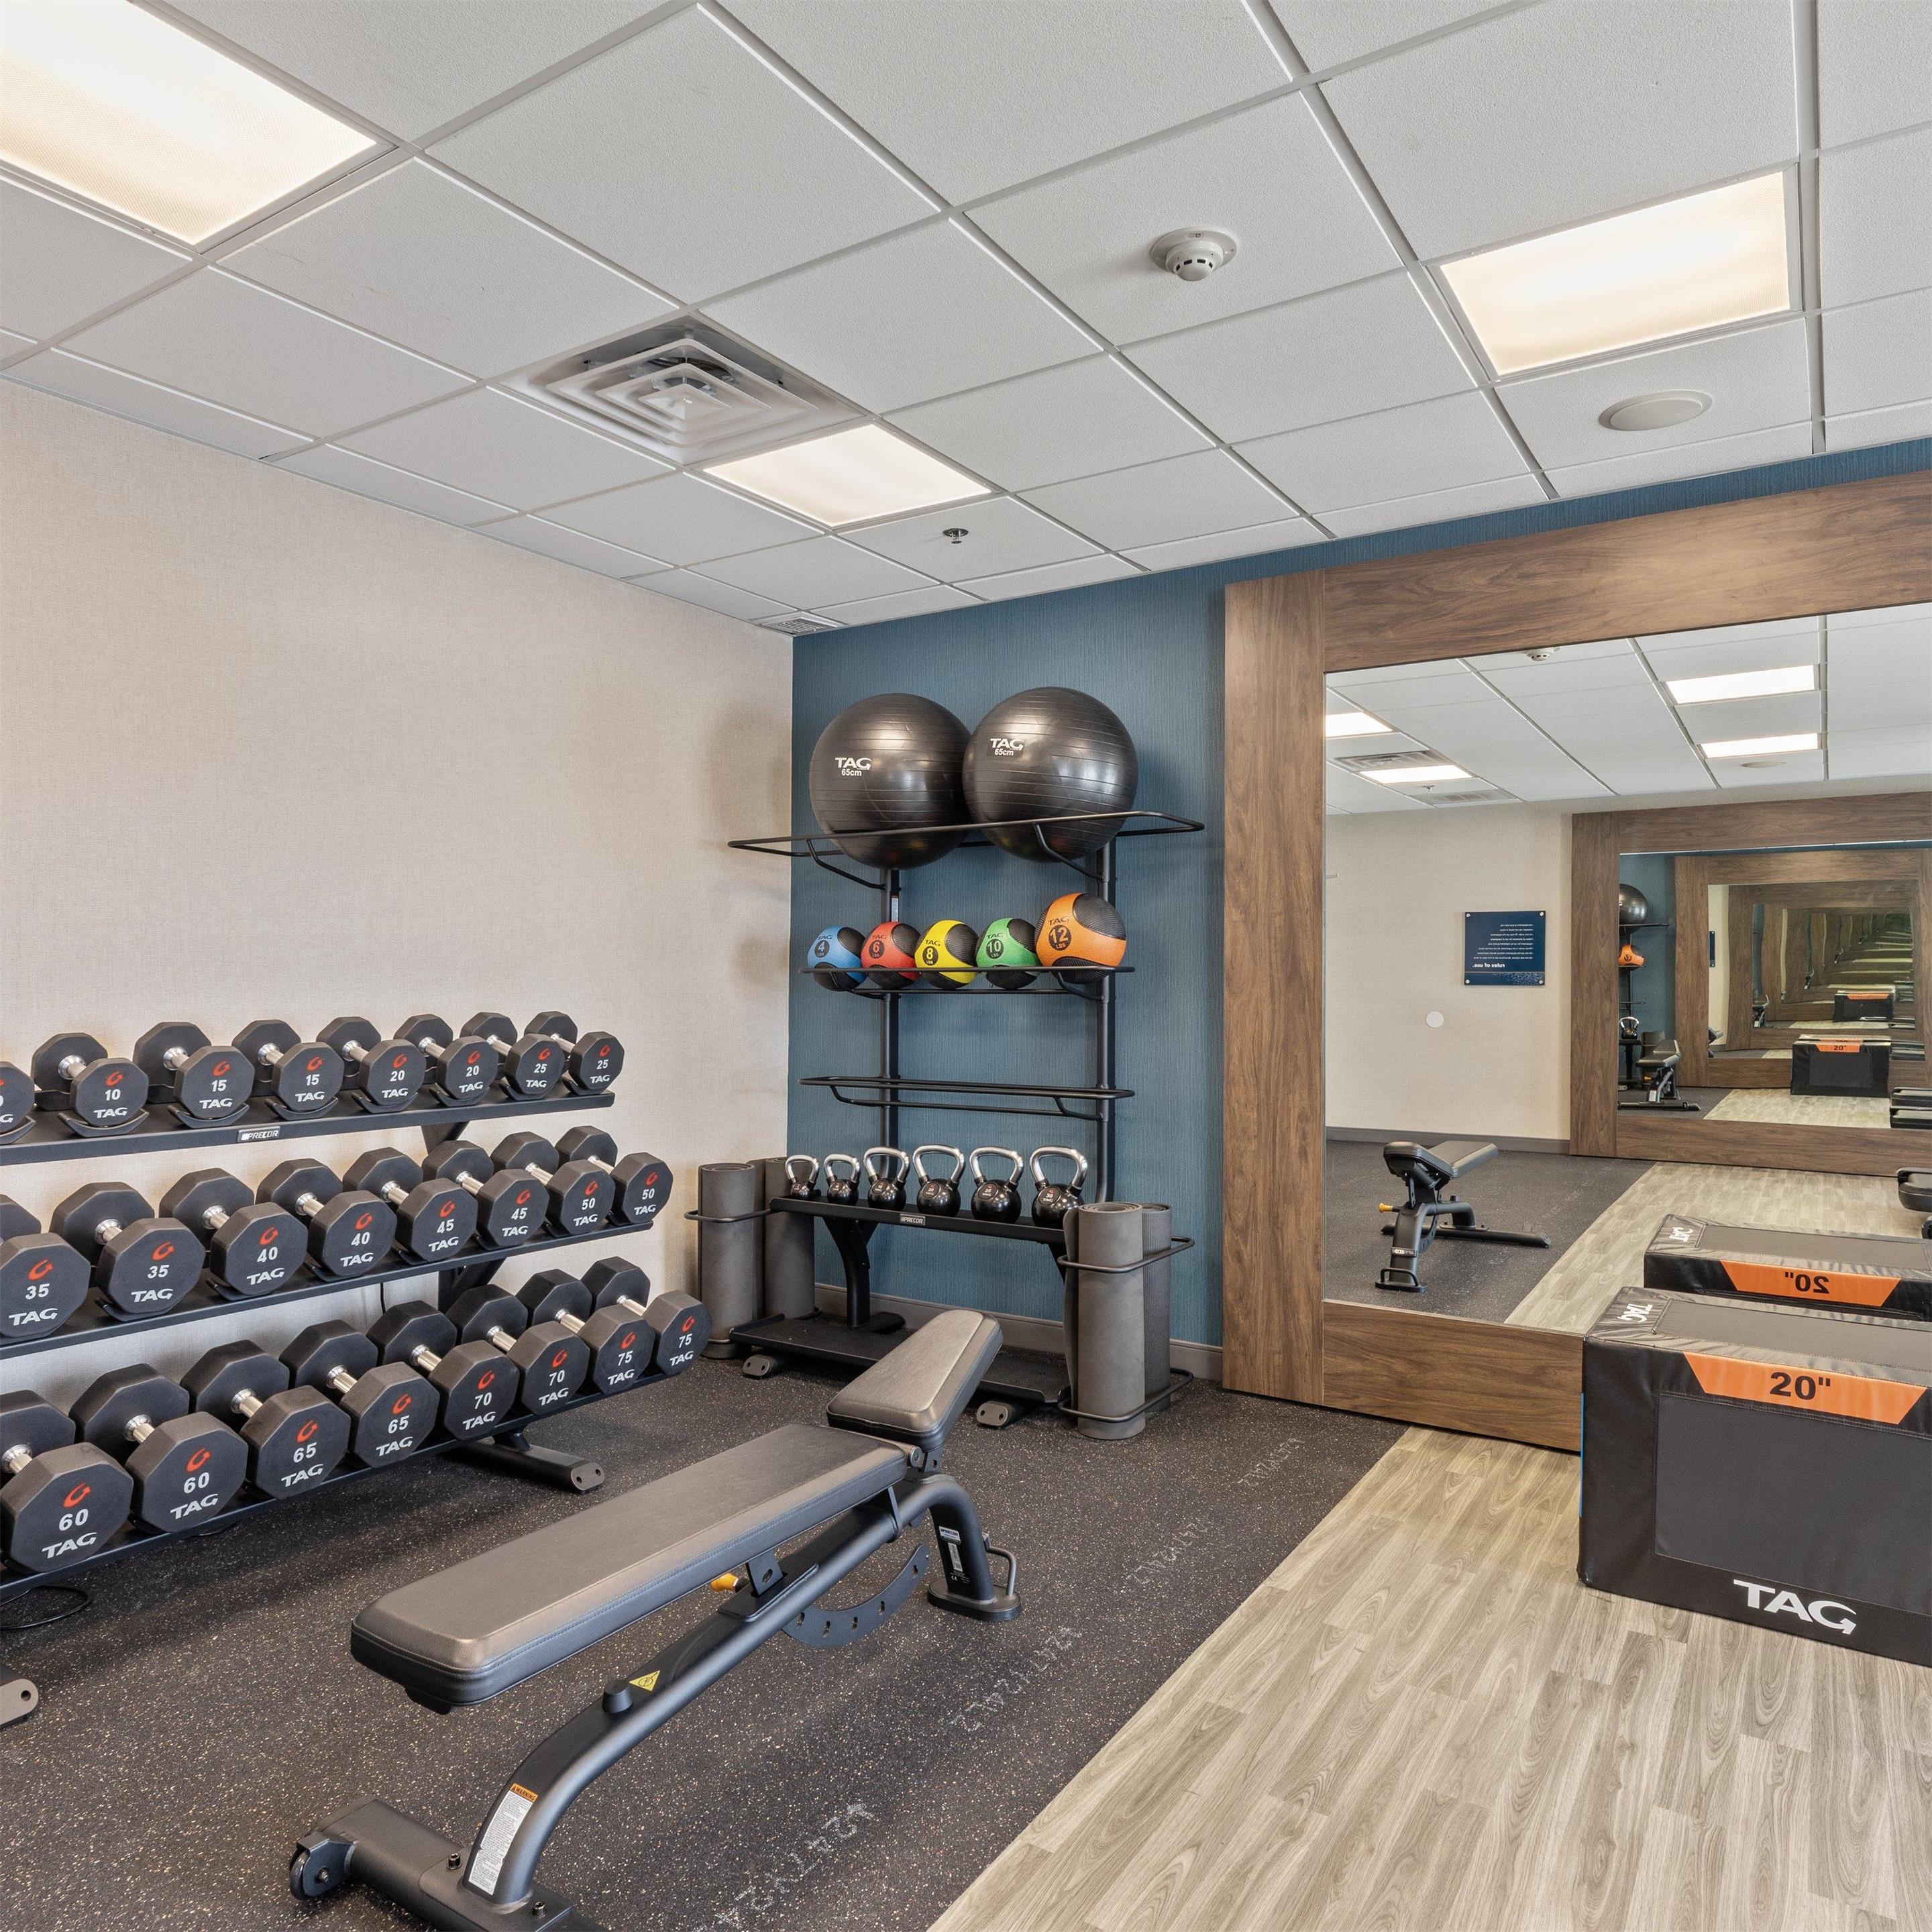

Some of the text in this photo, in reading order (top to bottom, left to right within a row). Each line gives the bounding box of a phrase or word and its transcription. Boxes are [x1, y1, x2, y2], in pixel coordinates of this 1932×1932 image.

[989, 738, 1025, 751] TAG
[994, 748, 1014, 756] 65cm
[835, 757, 872, 770] TAG
[841, 768, 862, 776] 65cm
[1048, 916, 1071, 926] TAG
[1049, 928, 1069, 944] 12
[818, 941, 825, 952] 4
[873, 941, 880, 953] 6
[926, 947, 933, 959] 8
[987, 943, 1002, 953] 10
[466, 1065, 480, 1077] 20
[533, 1063, 547, 1073] 25
[596, 1059, 609, 1070] 25
[306, 1073, 320, 1086] 15
[390, 1069, 405, 1082] 20
[590, 1074, 610, 1084] TAG
[211, 1079, 227, 1092] 15
[458, 1081, 484, 1093] TAG
[525, 1079, 547, 1088] TAG
[105, 1089, 121, 1102] 10
[294, 1091, 325, 1102] TAG
[381, 1087, 409, 1098] TAG
[199, 1097, 233, 1110] TAG
[93, 1107, 127, 1119] TAG
[247, 1130, 278, 1140] PRECOR
[641, 1188, 655, 1200] 50
[581, 1197, 596, 1210] 50
[634, 1204, 657, 1216] TAG
[511, 1207, 528, 1220] 45
[573, 1214, 598, 1226] TAG
[437, 1218, 455, 1234] 45
[502, 1226, 529, 1237] TAG
[351, 1232, 370, 1246] 40
[428, 1236, 459, 1252] TAG
[256, 1246, 278, 1263] 40
[340, 1252, 374, 1267] TAG
[147, 1265, 170, 1279] 35
[246, 1267, 284, 1285] TAG
[25, 1283, 50, 1300] 35
[131, 1288, 174, 1303] TAG
[8, 1307, 58, 1326] TAG
[1617, 1303, 1653, 1323] TAG
[678, 1333, 693, 1348] 75
[618, 1350, 633, 1366] 75
[669, 1350, 694, 1366] TAG
[549, 1369, 566, 1386] 70
[607, 1368, 635, 1385] TAG
[1770, 1372, 1831, 1400] 20"
[474, 1392, 492, 1409] 70
[538, 1387, 569, 1406] TAG
[388, 1415, 410, 1434] 65
[462, 1411, 496, 1430] TAG
[293, 1442, 317, 1463] 65
[376, 1436, 413, 1456] TAG
[280, 1464, 323, 1487] TAG
[183, 1472, 210, 1494] 60
[170, 1493, 219, 1521] TAG
[58, 1508, 89, 1531] 60
[42, 1532, 97, 1560] TAG
[1733, 1578, 1857, 1635] TAG
